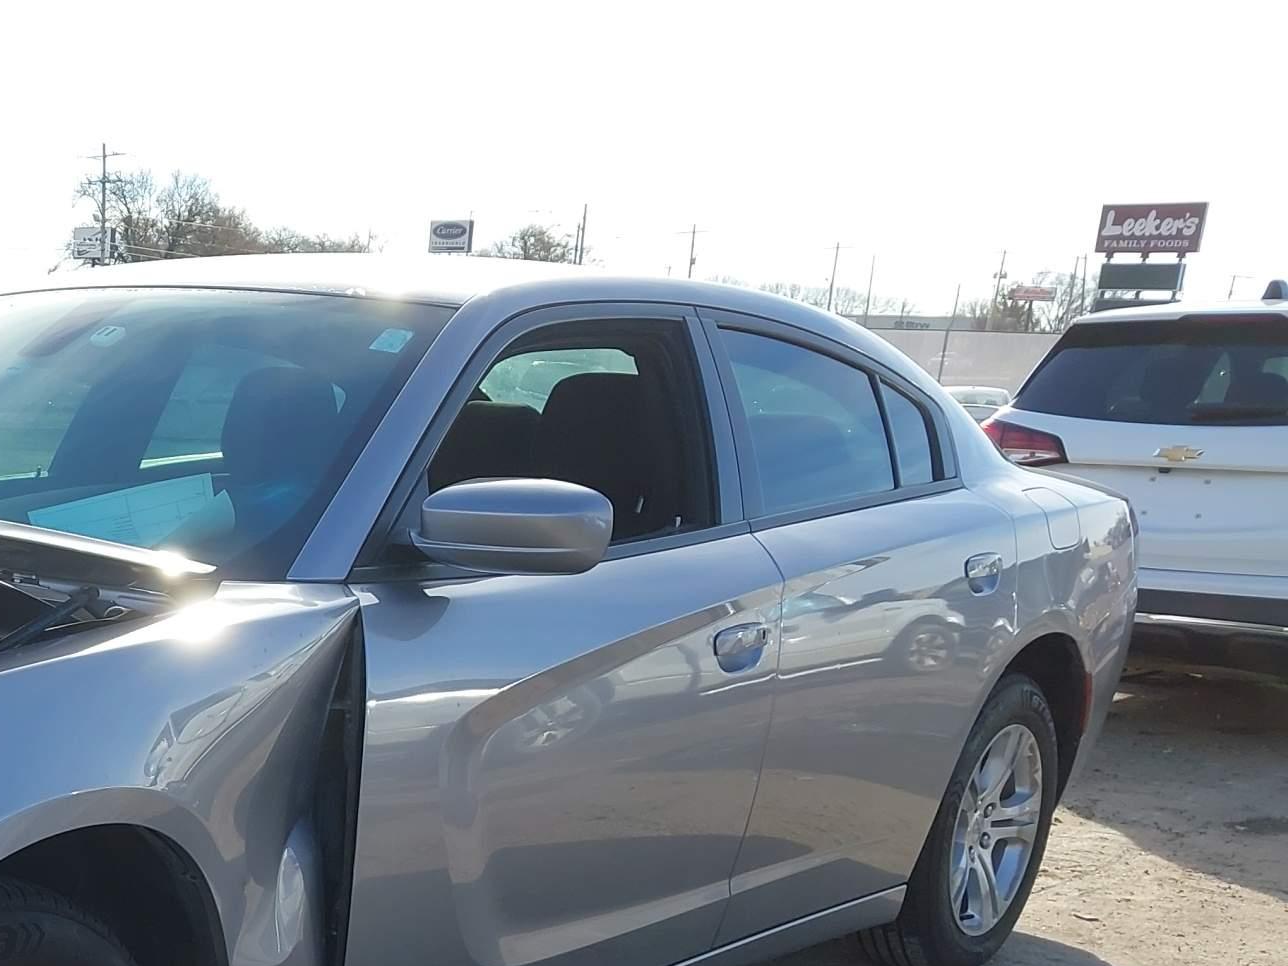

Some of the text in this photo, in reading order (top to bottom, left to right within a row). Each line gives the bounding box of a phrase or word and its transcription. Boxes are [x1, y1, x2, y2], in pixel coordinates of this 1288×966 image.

[1101, 209, 1199, 236] Leeker's
[1103, 240, 1190, 248] FAMILY FOODS
